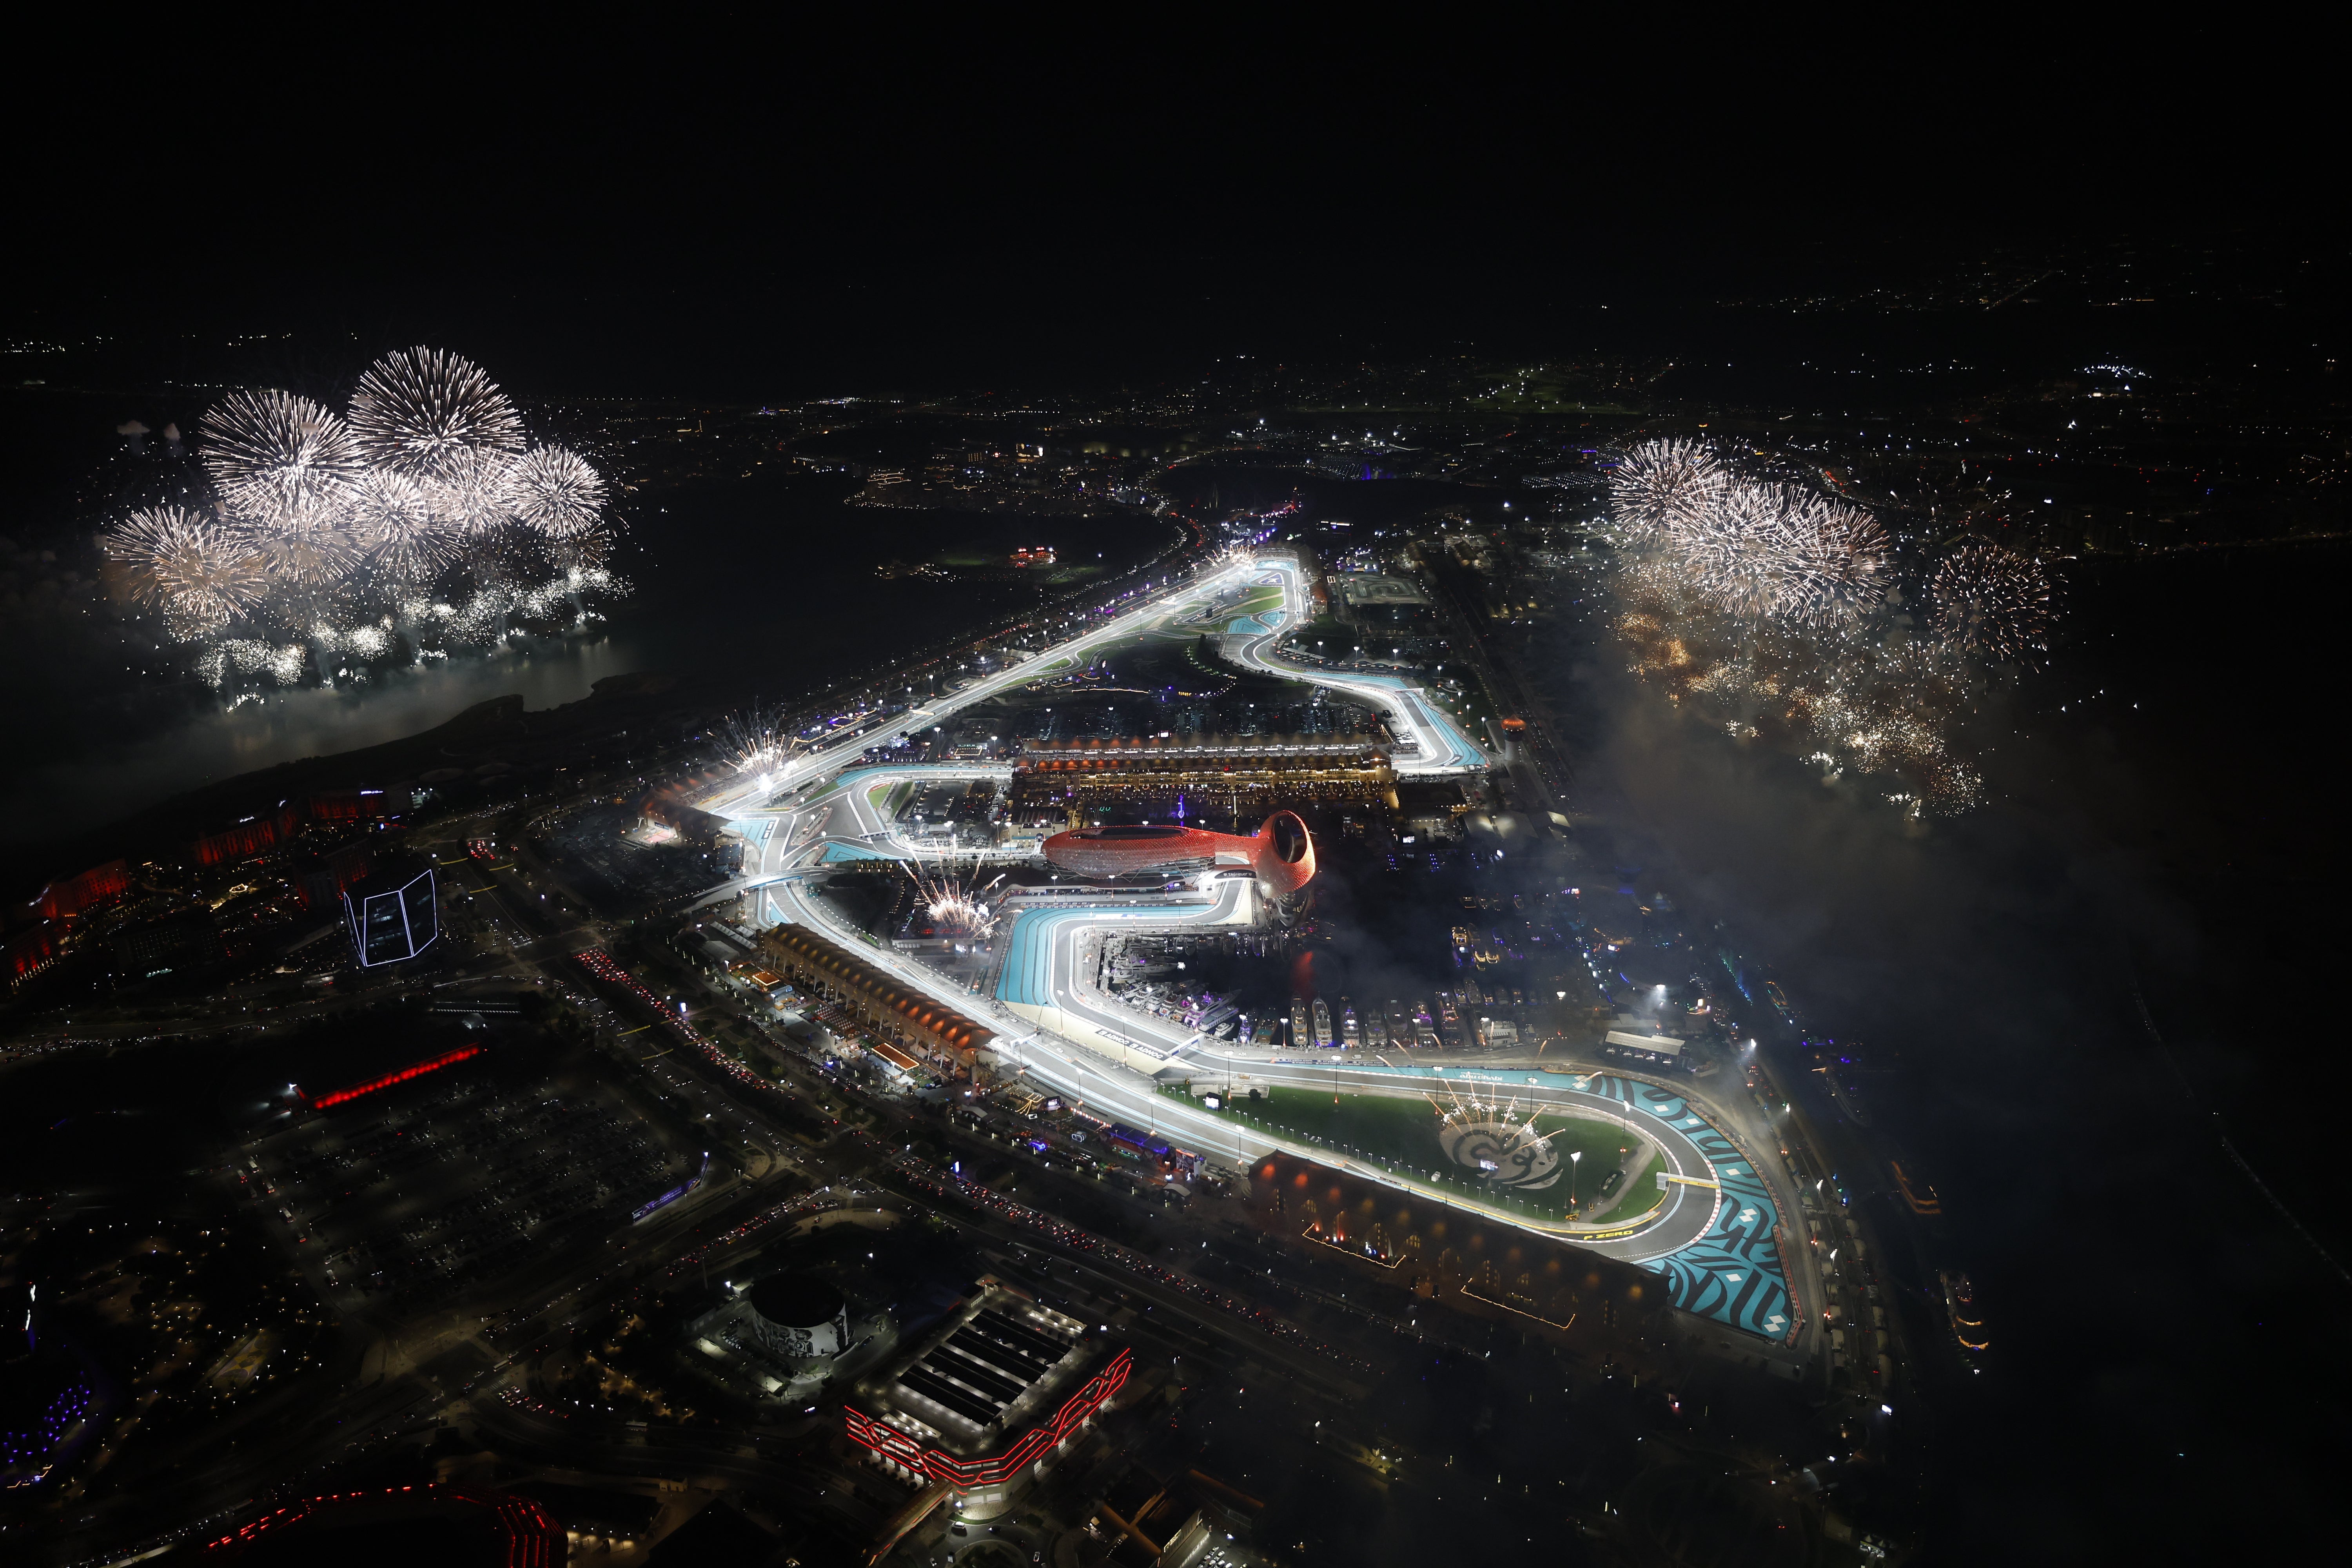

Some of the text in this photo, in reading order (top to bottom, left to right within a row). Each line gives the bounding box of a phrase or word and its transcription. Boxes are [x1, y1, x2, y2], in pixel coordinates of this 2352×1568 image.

[1104, 1033, 1129, 1045] ADNOC
[1136, 1047, 1163, 1058] ADNOC
[1596, 1230, 1633, 1239] ZERO
